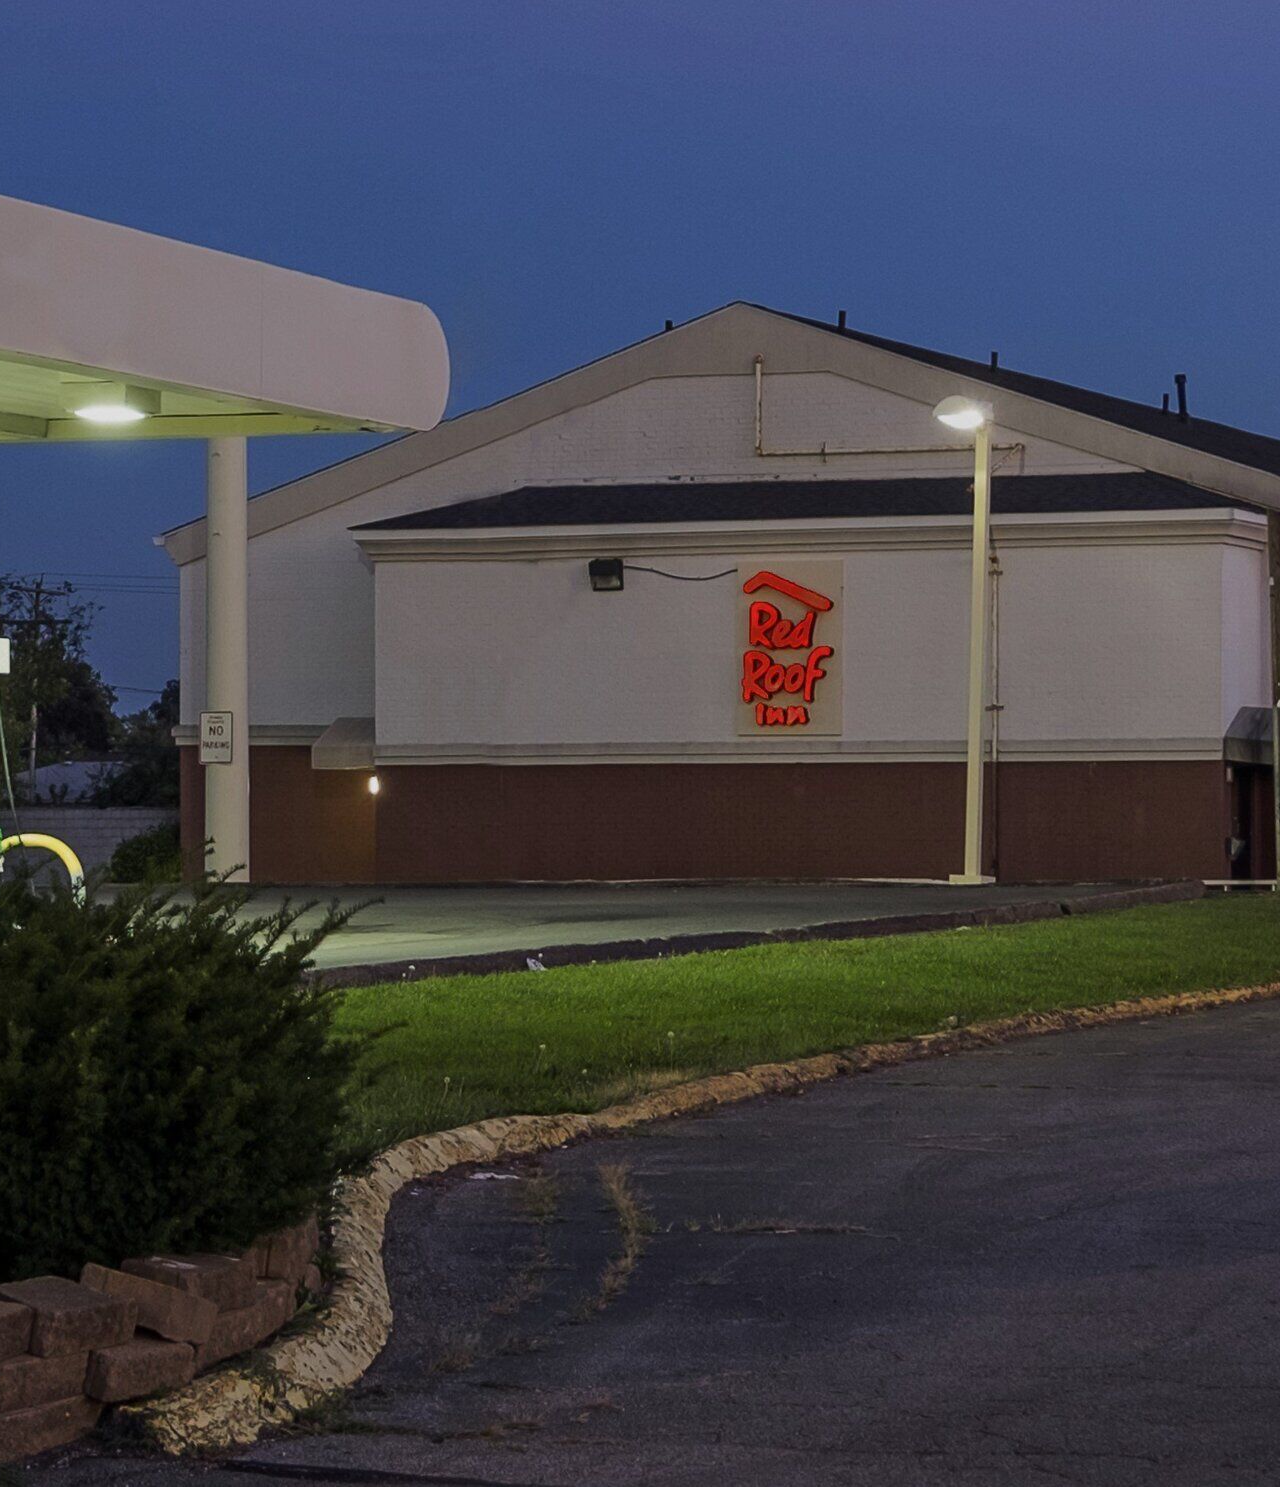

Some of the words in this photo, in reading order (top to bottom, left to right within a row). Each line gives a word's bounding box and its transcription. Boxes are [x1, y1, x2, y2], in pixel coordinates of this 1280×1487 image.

[749, 601, 817, 650] Red
[741, 645, 834, 704] Roof
[208, 725, 224, 736] NO
